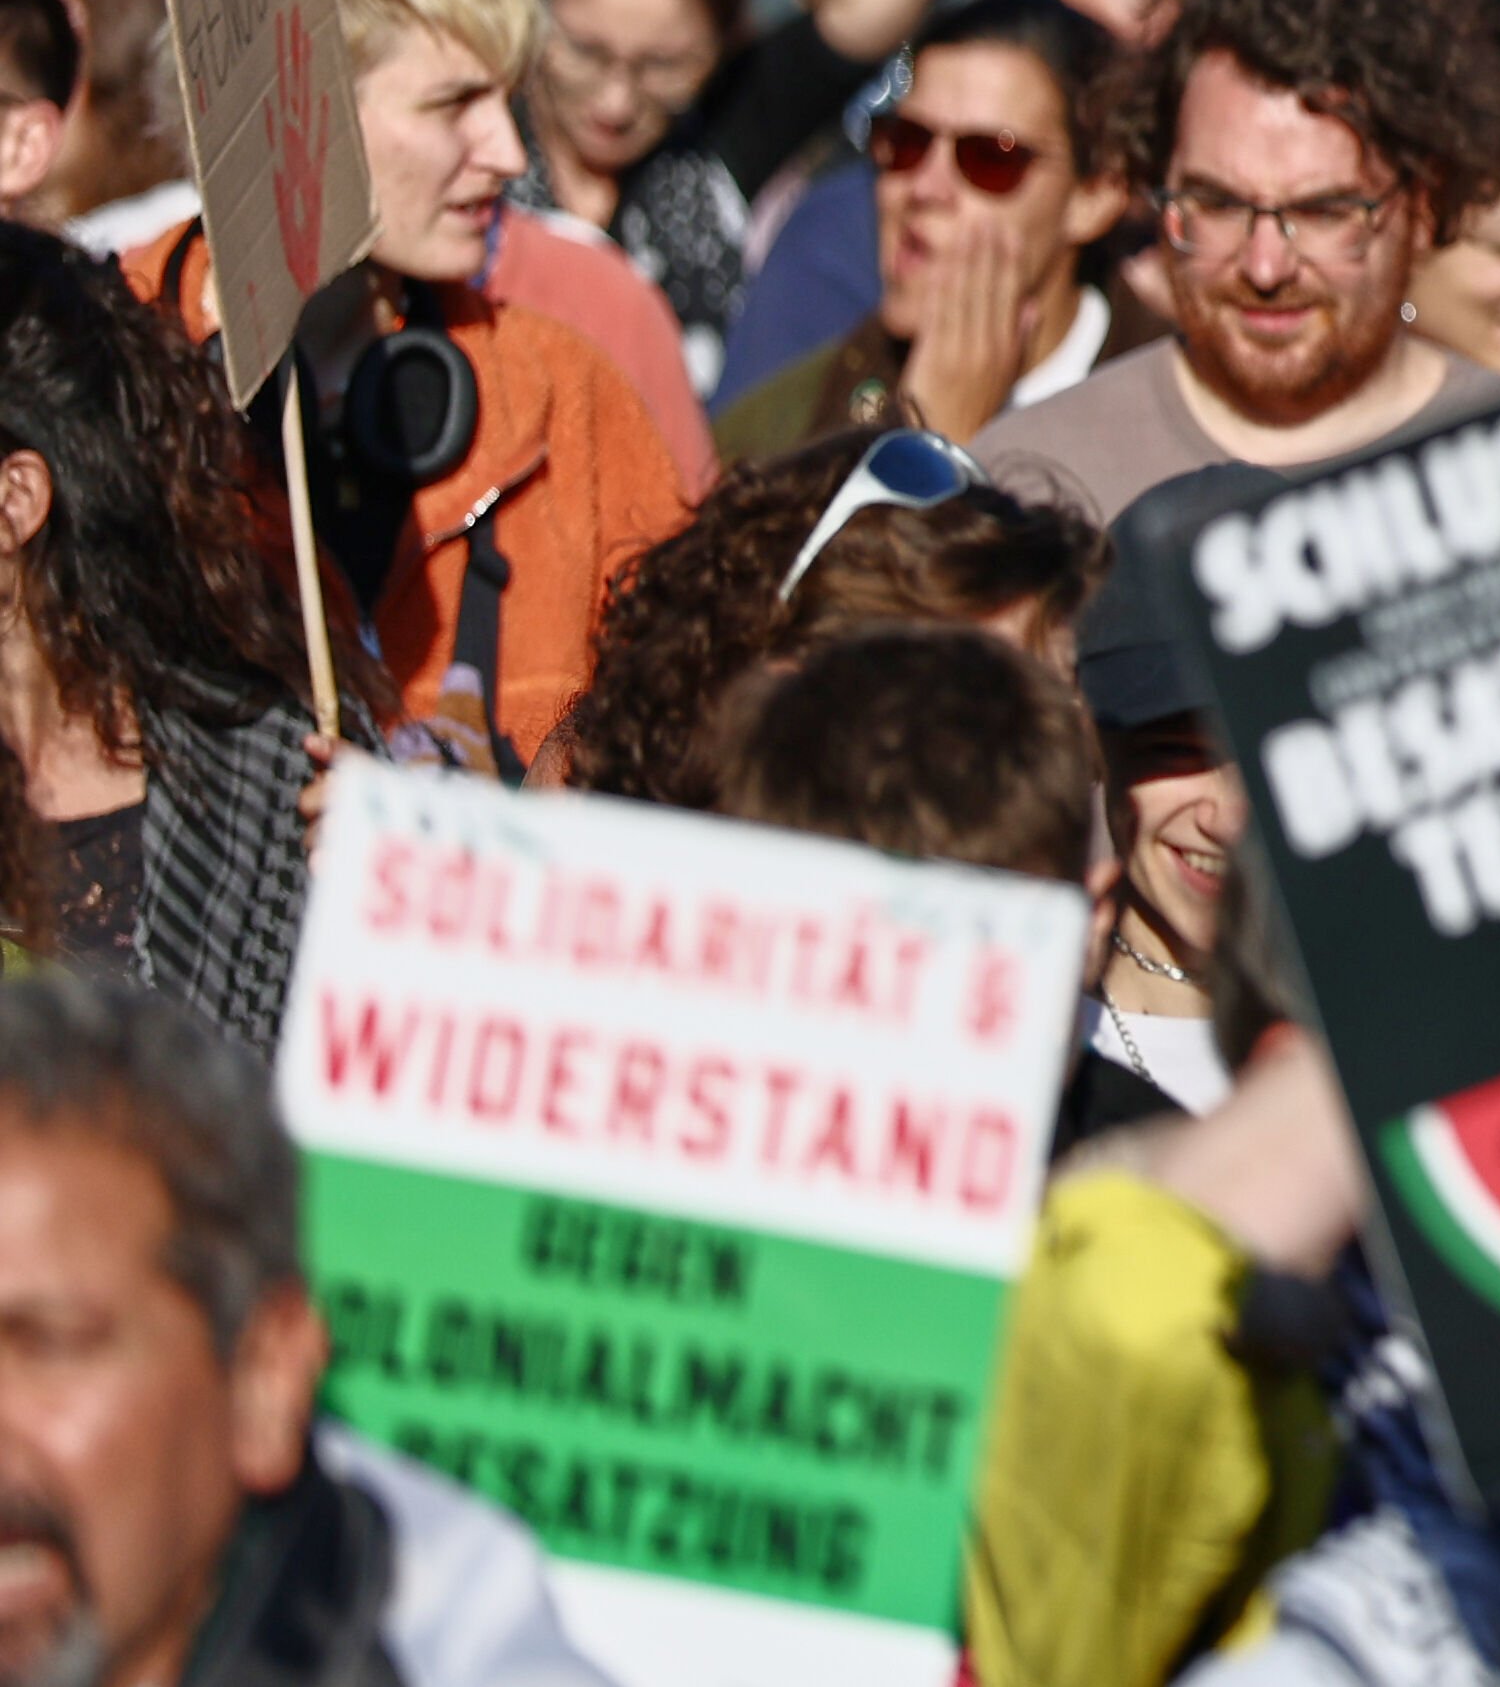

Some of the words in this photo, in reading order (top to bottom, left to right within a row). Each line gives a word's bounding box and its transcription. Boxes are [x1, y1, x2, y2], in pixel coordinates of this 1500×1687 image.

[363, 831, 927, 1027] SOLIDARITÄT
[315, 982, 1023, 1216] WIDERSTAND
[520, 1200, 752, 1308] GEGEN
[328, 1280, 968, 1486] OLONIALMACHT
